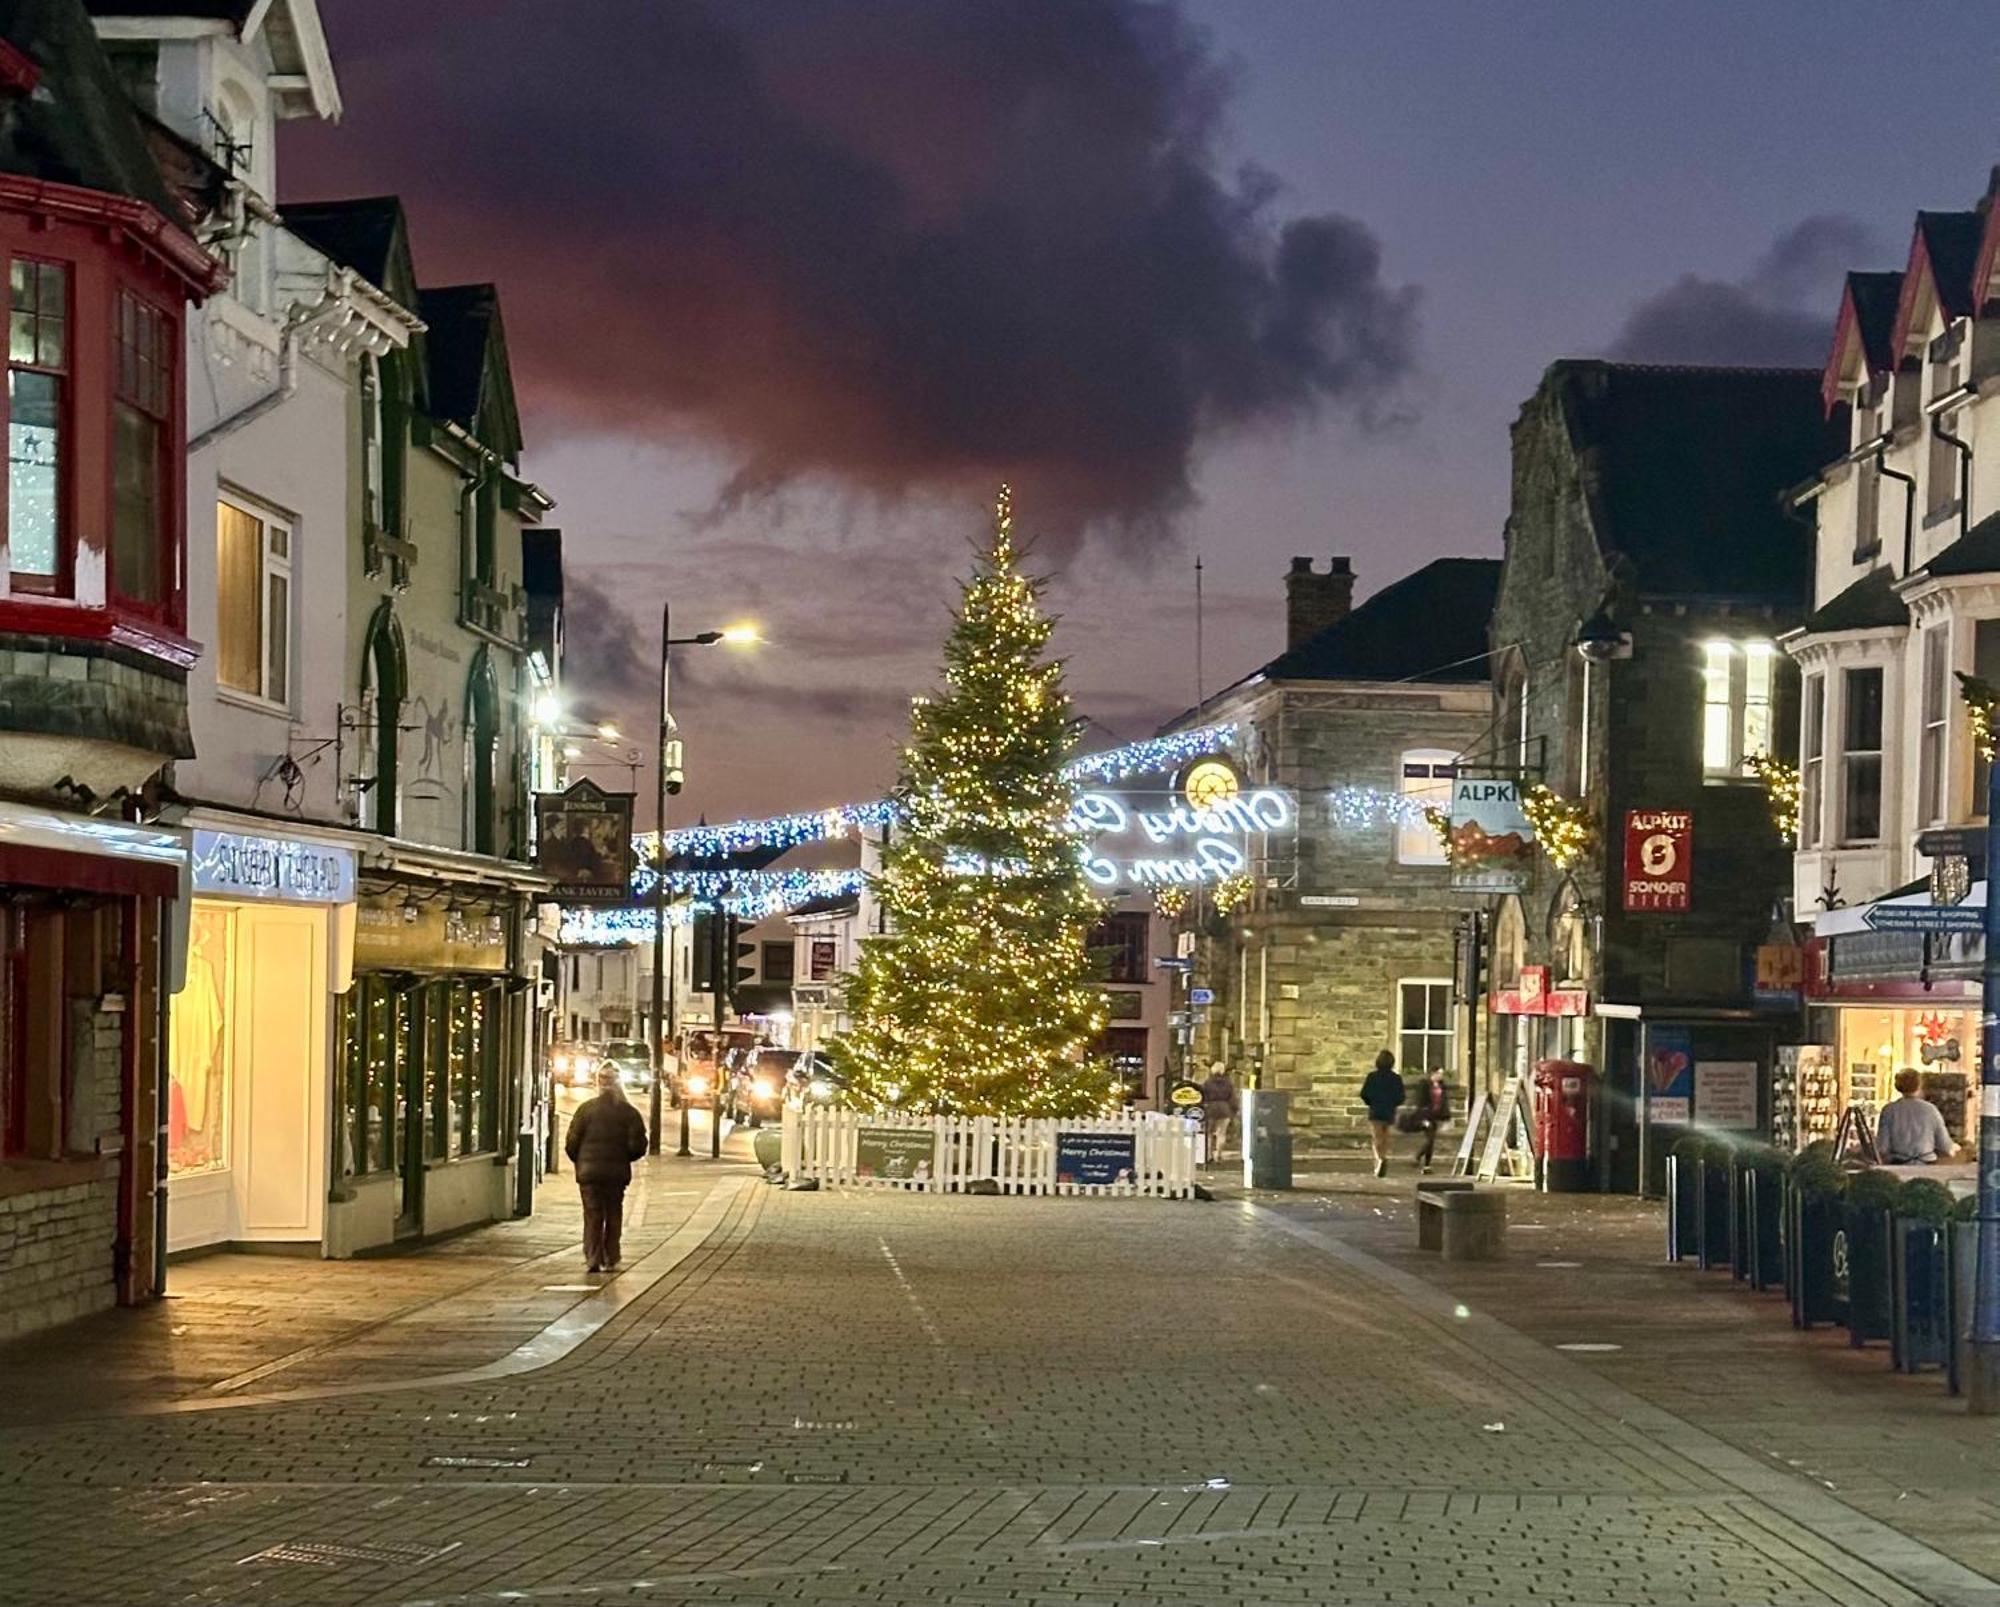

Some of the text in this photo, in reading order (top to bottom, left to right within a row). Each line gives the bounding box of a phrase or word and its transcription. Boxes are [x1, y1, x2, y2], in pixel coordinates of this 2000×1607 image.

[1458, 785, 1518, 802] ALPKI
[1631, 815, 1689, 830] ALPKIT
[579, 886, 621, 897] TAVERN
[1628, 881, 1686, 894] SONDER
[1940, 911, 1979, 920] SHOPPING
[1916, 920, 1944, 928] STREET
[1946, 921, 1984, 929] SHOPPING
[862, 1140, 931, 1149] Merry Christmas
[1061, 1148, 1131, 1158] Merry Christmas
